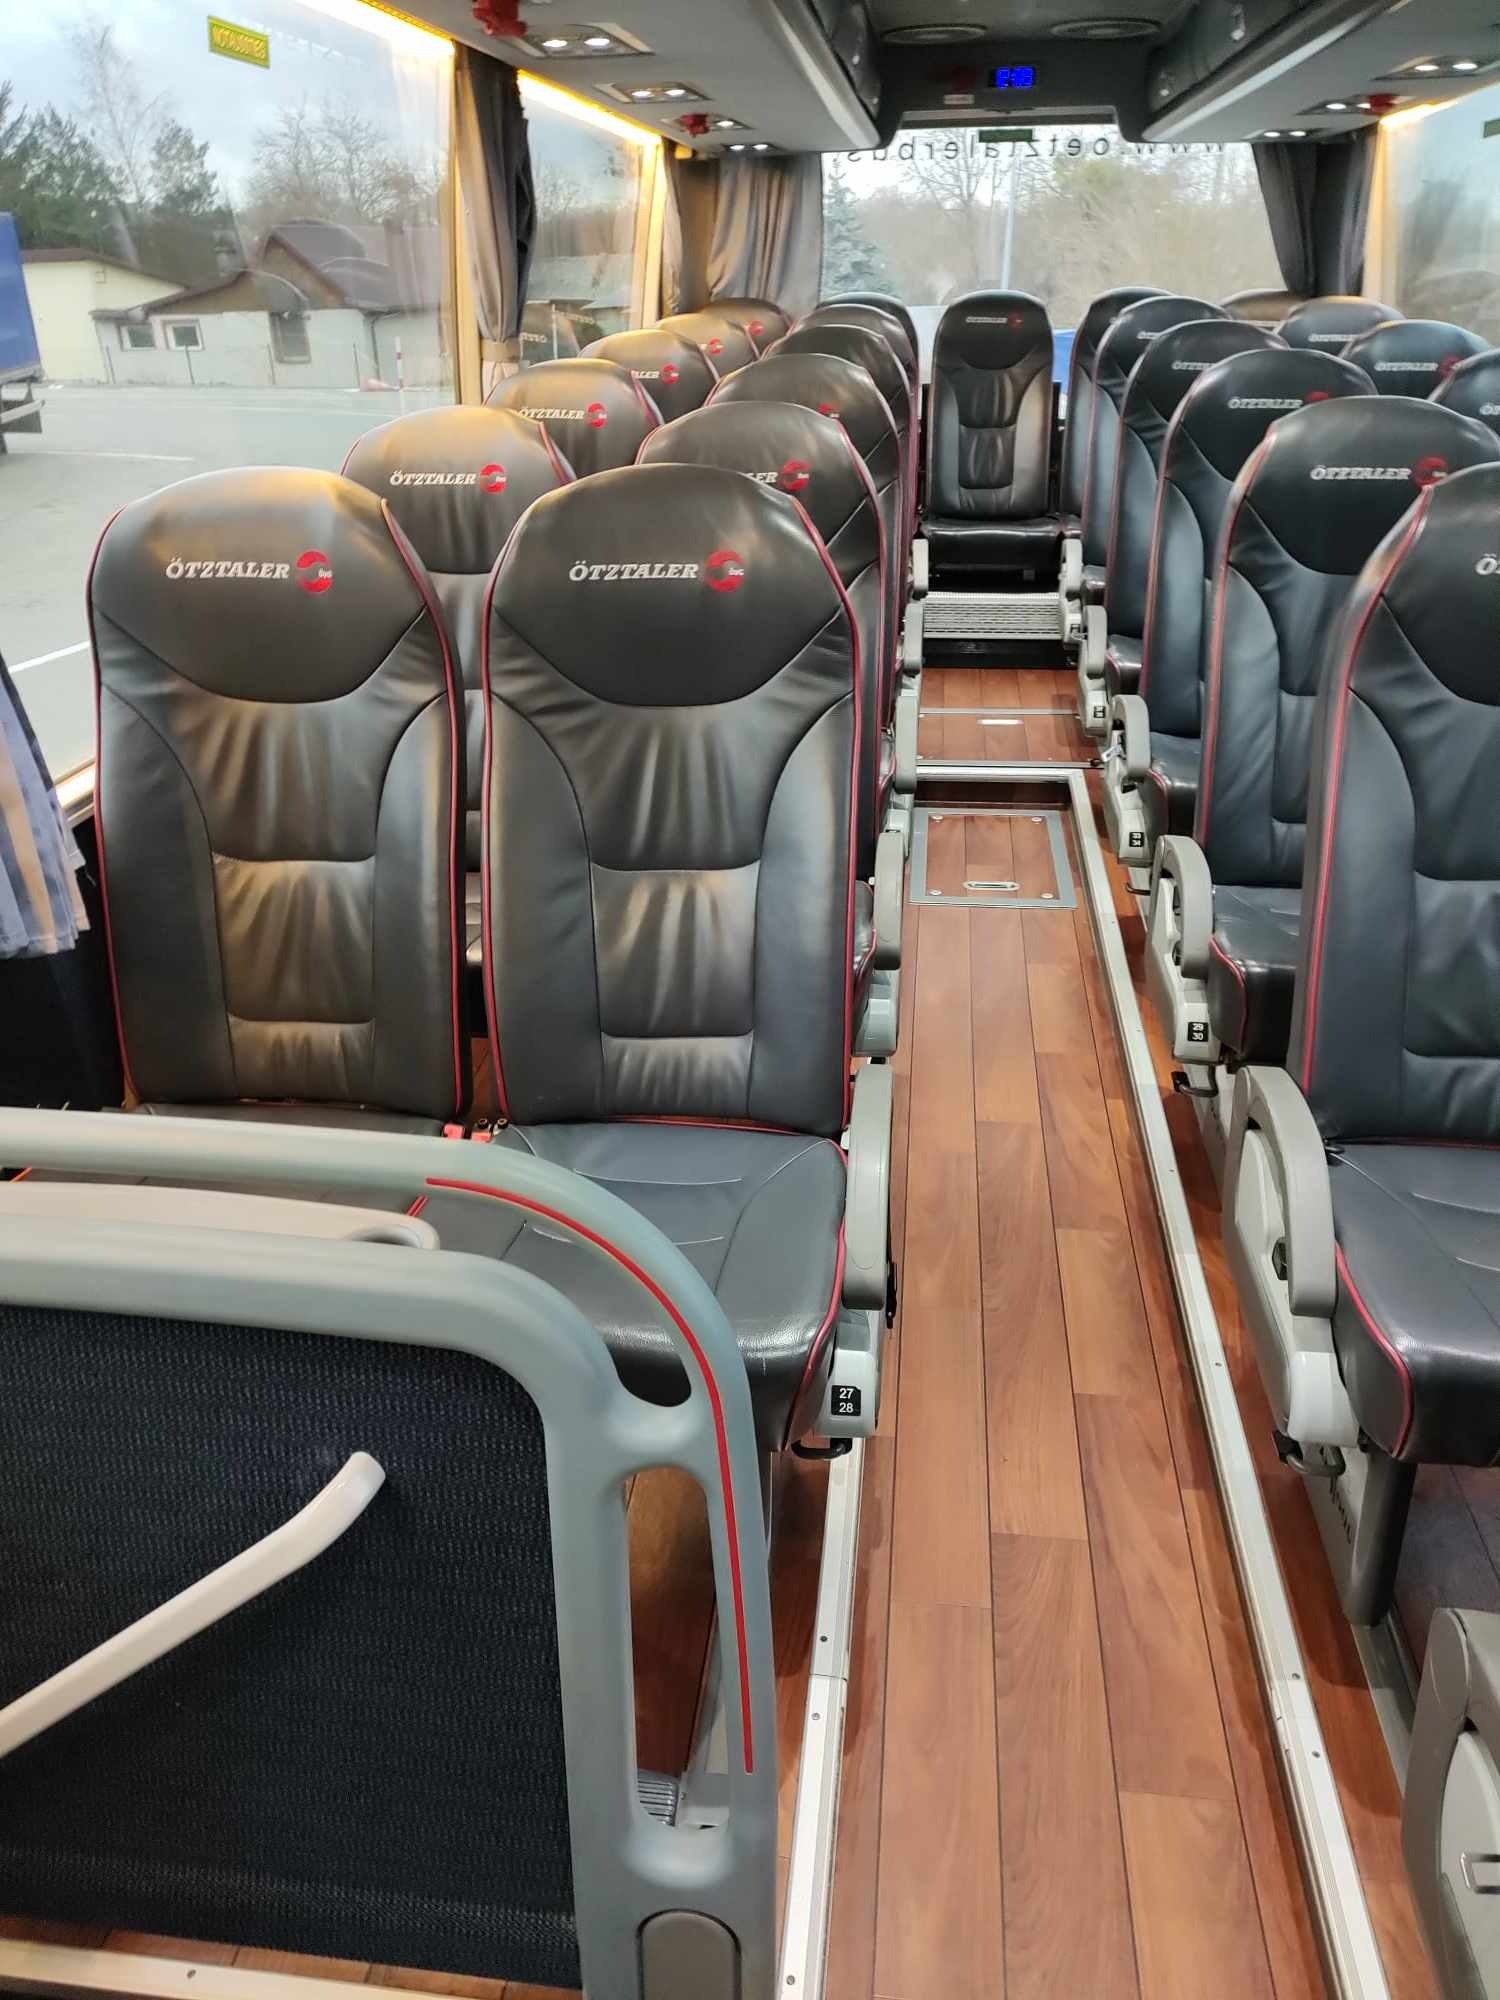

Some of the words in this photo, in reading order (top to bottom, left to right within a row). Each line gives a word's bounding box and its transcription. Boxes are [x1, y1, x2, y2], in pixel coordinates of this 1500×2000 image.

[519, 406, 585, 420] ÖTZTALER
[389, 470, 477, 486] ÖTZTALER
[1310, 465, 1412, 480] ÖTZTALER
[165, 556, 291, 580] ÖTZTALER
[569, 560, 699, 581] ÖTZTALER
[839, 1387, 854, 1399] 27
[839, 1402, 854, 1413] 28
